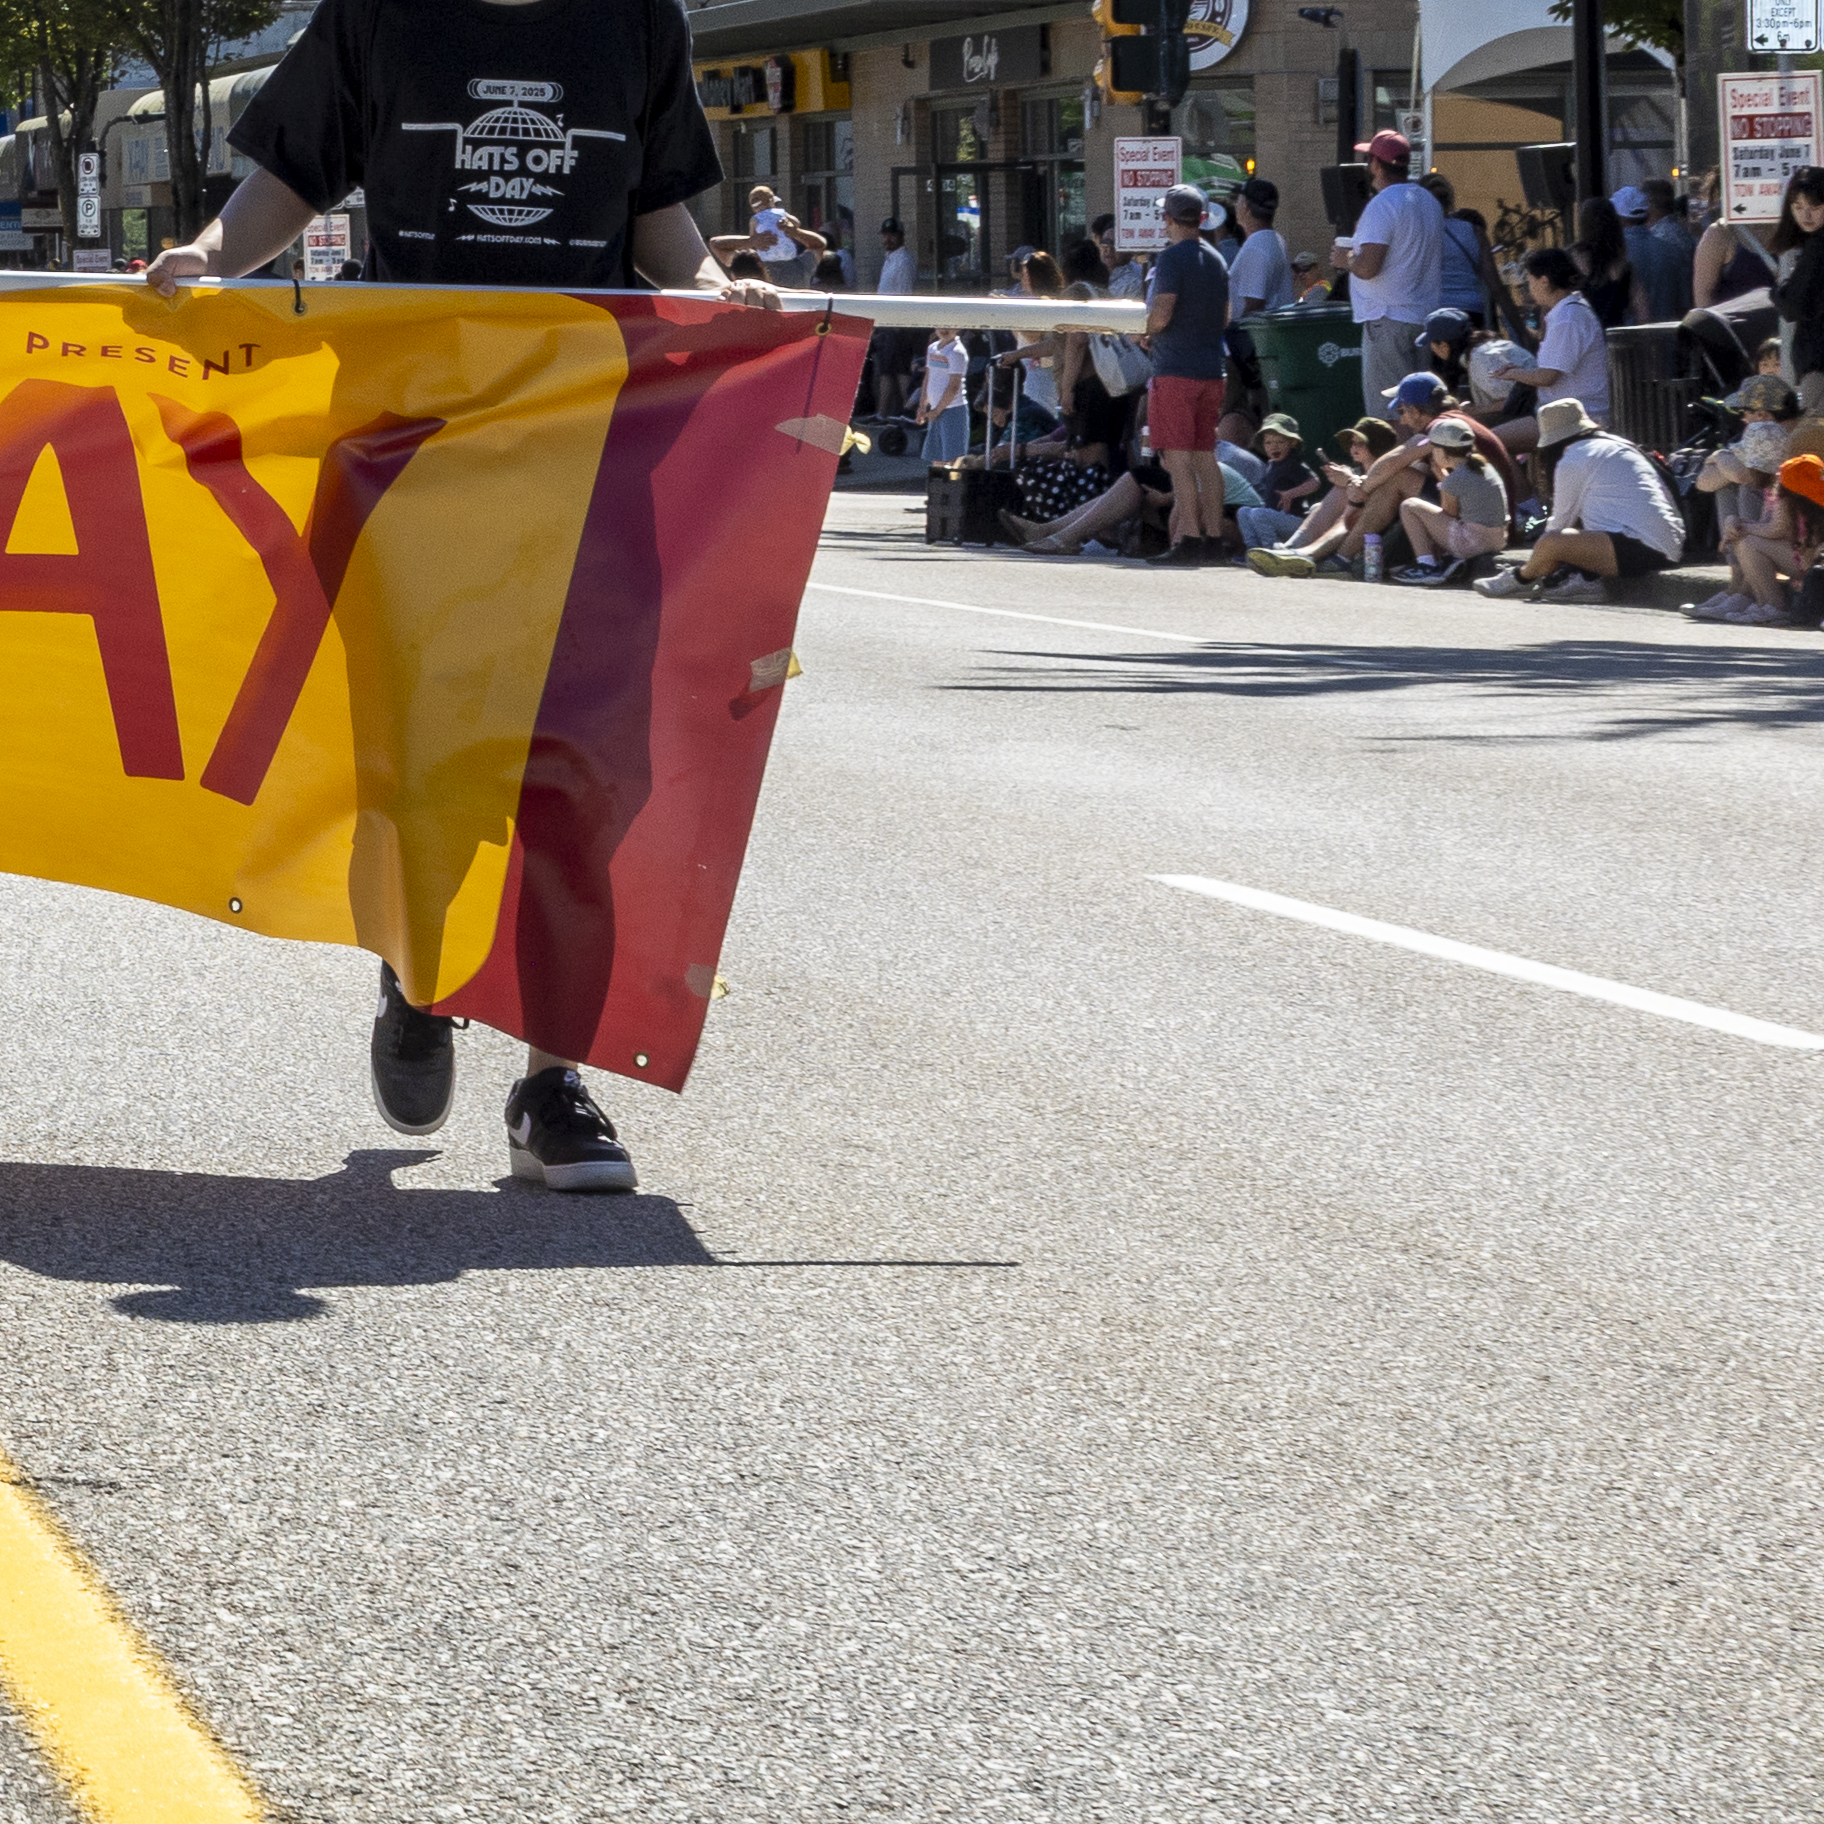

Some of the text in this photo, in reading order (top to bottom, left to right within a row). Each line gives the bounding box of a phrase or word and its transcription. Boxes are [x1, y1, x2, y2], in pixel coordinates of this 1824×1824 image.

[1770, 7, 1796, 18] EXCEPT
[1756, 18, 1813, 29] 3:30pm-6pm
[482, 85, 507, 96] JUNE
[521, 87, 547, 97] 2025
[1730, 86, 1811, 111] Special Event
[1731, 114, 1812, 139] NO STOPPING
[455, 145, 579, 175] HATS OFF
[1119, 146, 1175, 165] Special Event
[1136, 170, 1174, 187] STOPPING
[1733, 163, 1763, 178] 7am
[489, 176, 535, 199] DAY
[1123, 209, 1142, 221] 7am
[26, 331, 262, 382] PRESENT
